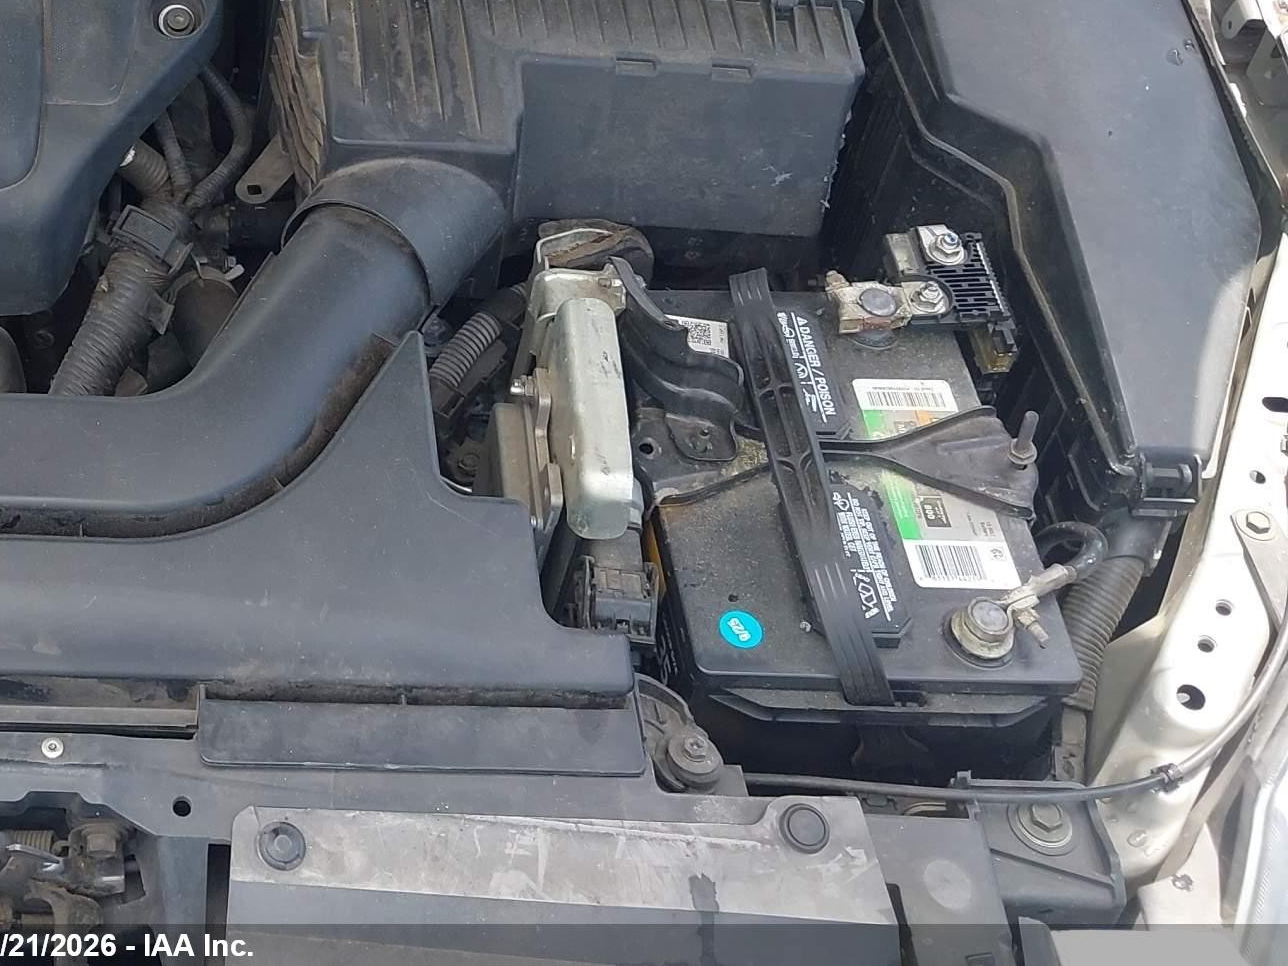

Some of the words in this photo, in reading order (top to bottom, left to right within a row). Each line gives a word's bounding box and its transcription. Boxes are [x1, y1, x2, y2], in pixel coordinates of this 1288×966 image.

[800, 326, 822, 367] DANGER
[815, 377, 837, 416] POISON
[924, 504, 936, 520] 800
